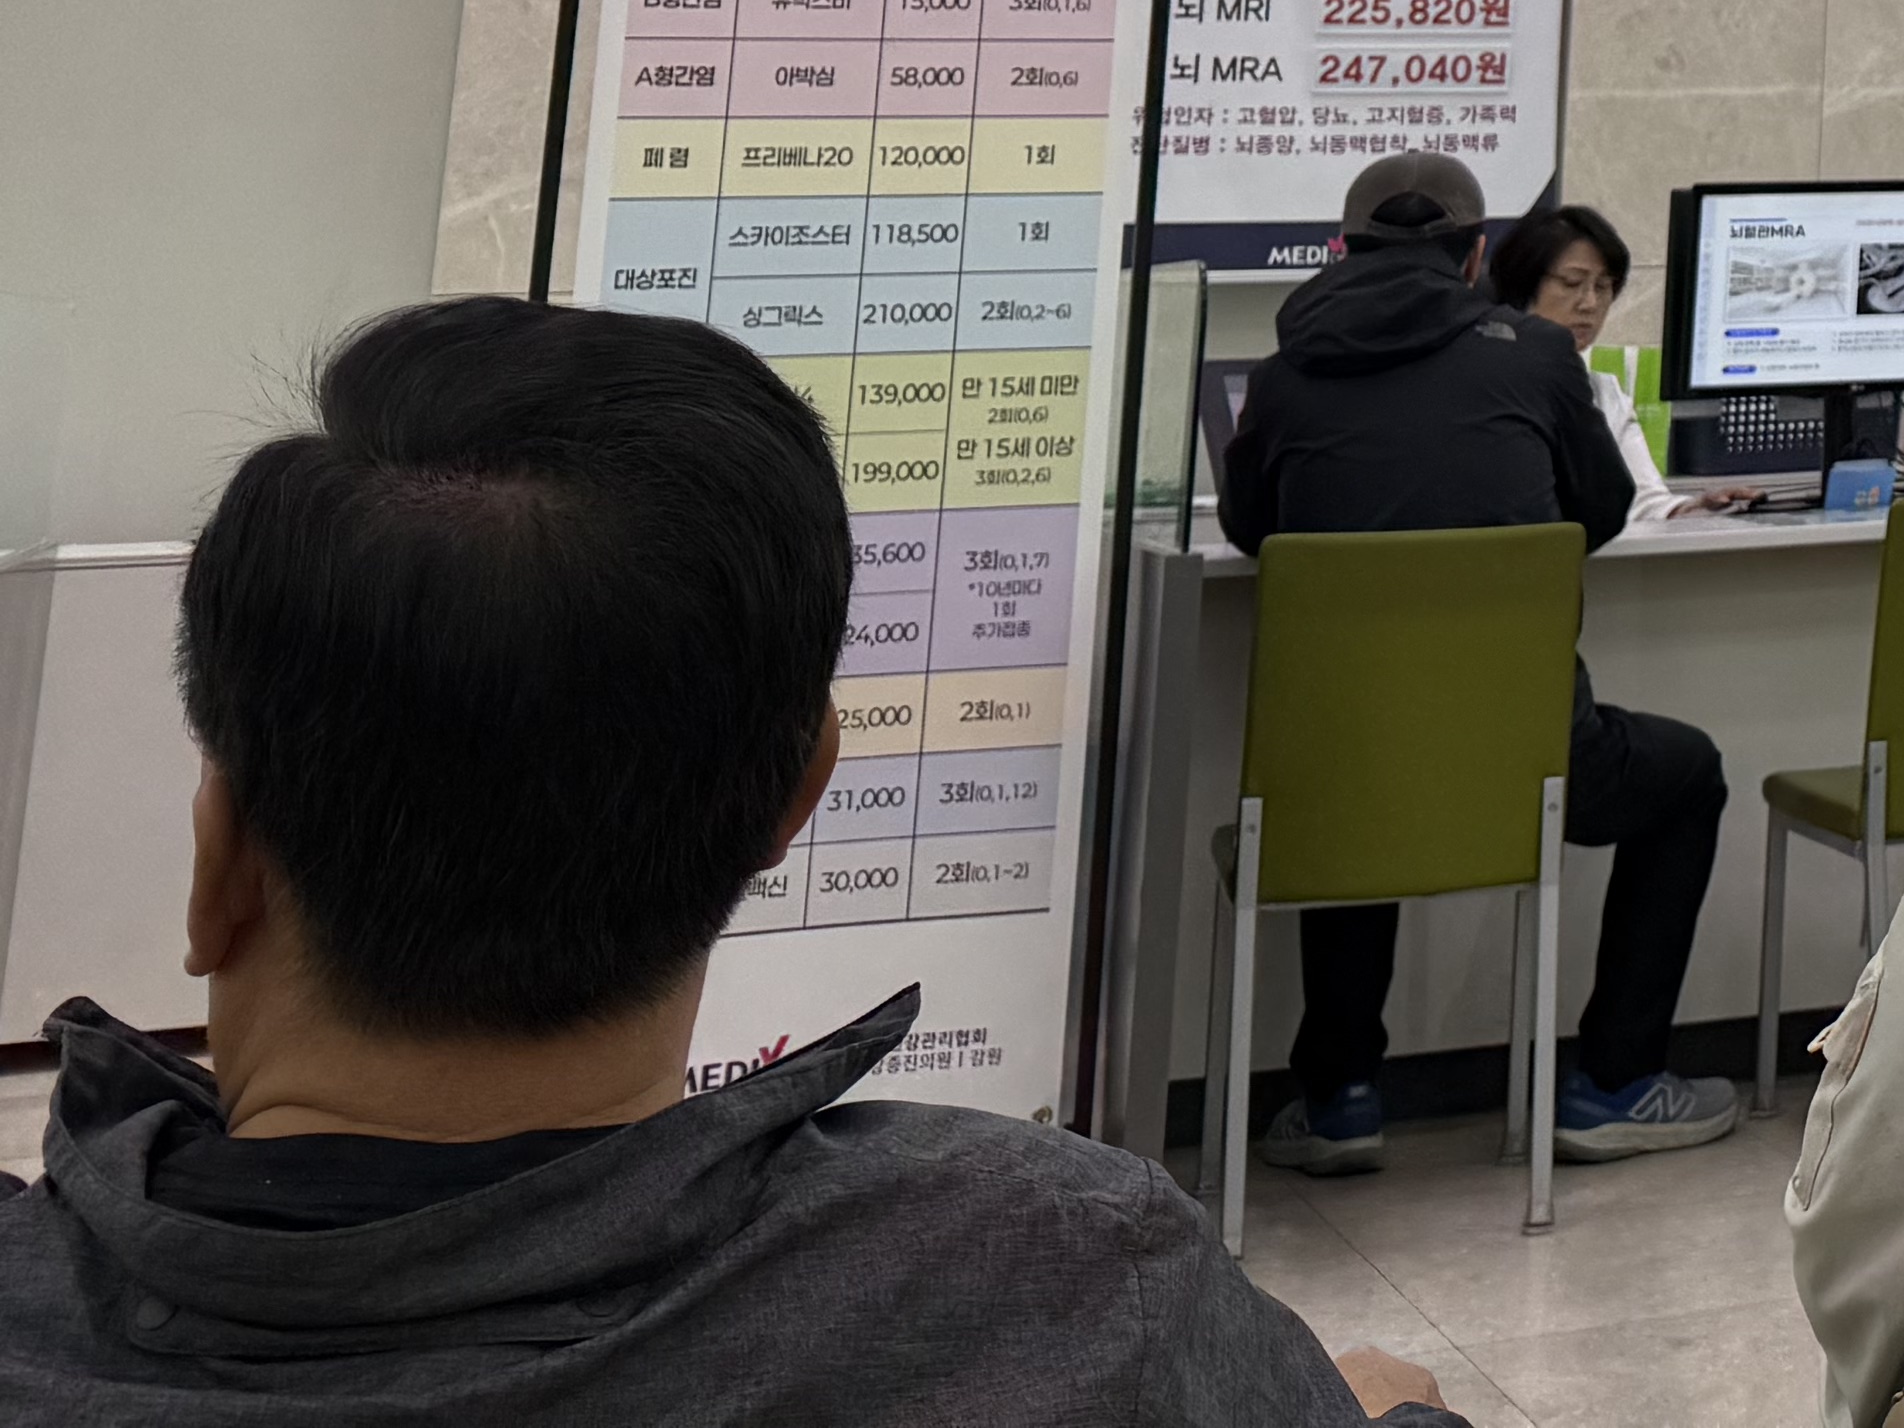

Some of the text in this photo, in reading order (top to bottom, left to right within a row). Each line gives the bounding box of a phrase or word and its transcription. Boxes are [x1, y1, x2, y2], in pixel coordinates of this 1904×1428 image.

[635, 65, 1079, 89] A형간염 아박심 58,000 2회(0,6)
[1170, 52, 1507, 88] 뇌 MRA 247,040원
[741, 146, 853, 169] 프리베나20
[878, 146, 966, 169] 120,000
[1024, 144, 1056, 166] 1회
[728, 220, 1050, 248] 스카이조스터 118,500 1회
[614, 267, 698, 292] 대상포진
[742, 305, 824, 327] 싱그릭스
[862, 301, 953, 325] 210,000
[857, 375, 1080, 406] 139,000 만 15세 미만
[851, 436, 1075, 483] 199,000 만 15세 이상
[838, 705, 912, 729] 25,000
[826, 786, 905, 811] 31,000
[819, 867, 898, 893] 30,000
